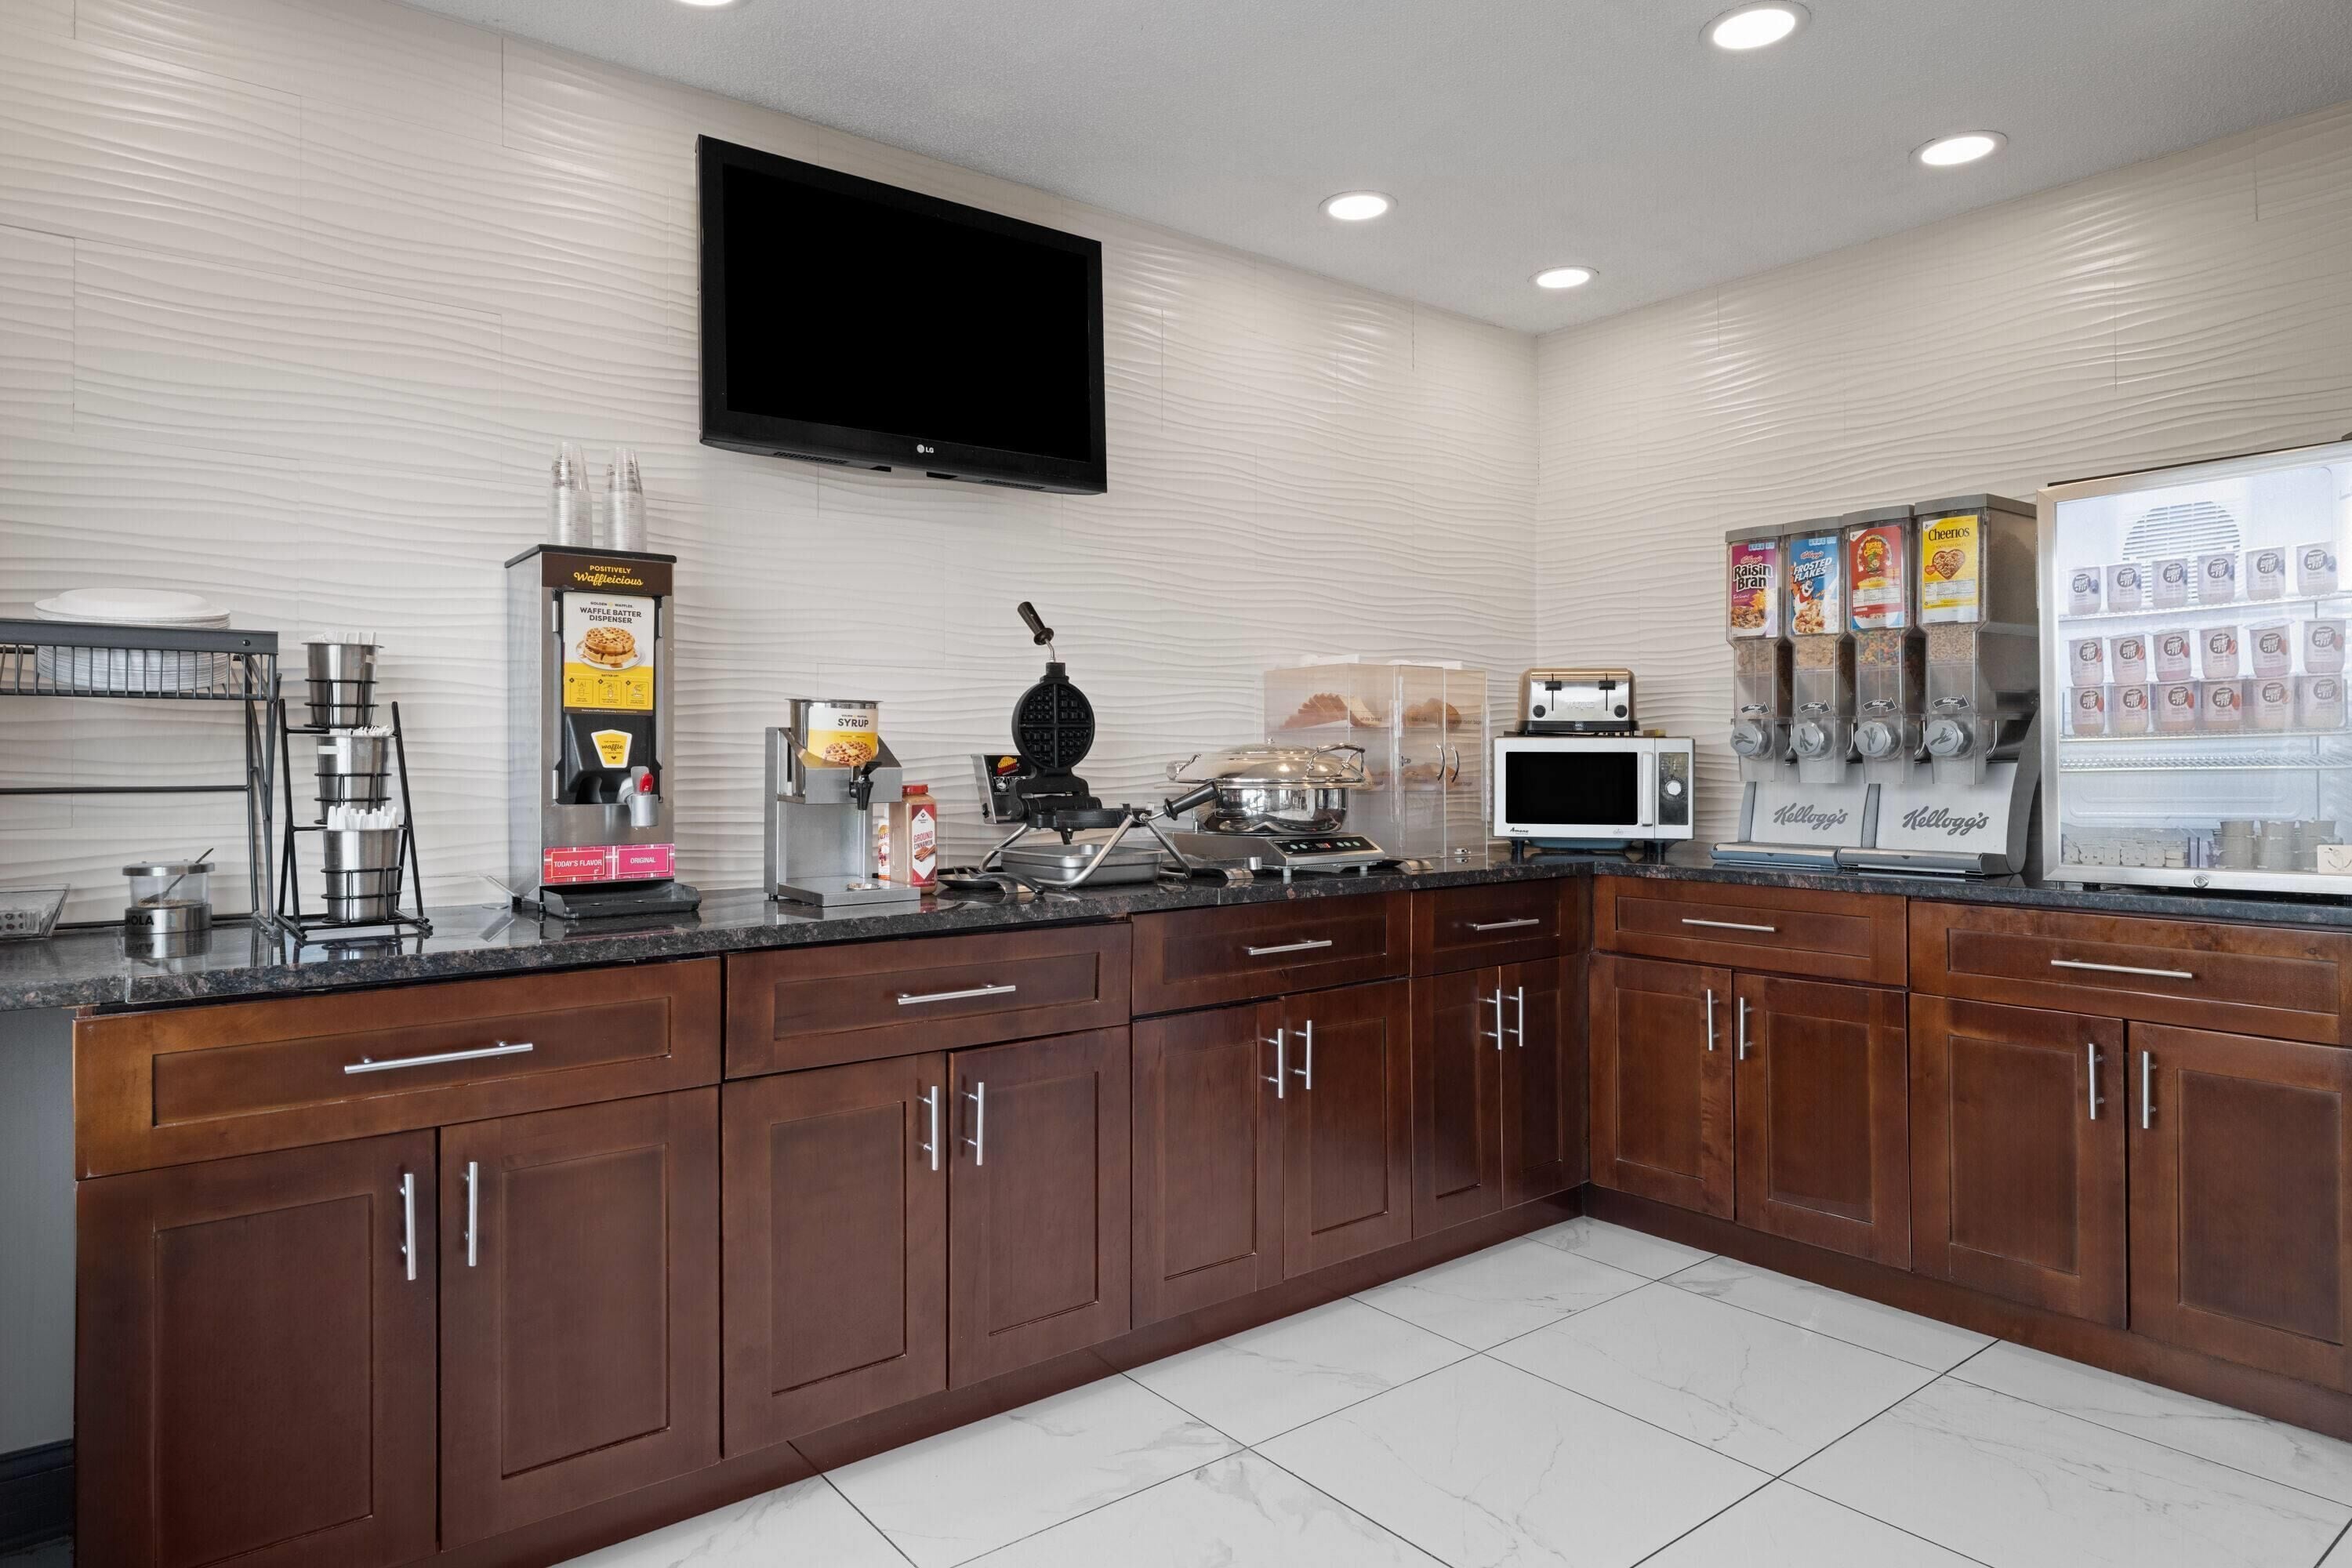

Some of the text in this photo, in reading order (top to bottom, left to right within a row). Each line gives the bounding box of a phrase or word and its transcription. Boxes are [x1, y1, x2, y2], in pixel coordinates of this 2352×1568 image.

[1929, 528, 1970, 542] Cheerios
[590, 565, 631, 574] POSITIVELY
[1794, 557, 1832, 575] FROSTED
[2211, 563, 2227, 572] LIGHT
[1734, 564, 1772, 579] Raisin
[1794, 567, 1826, 583] FLAKES
[574, 572, 644, 586] Waffleicious
[1737, 577, 1766, 590] Bran
[580, 607, 611, 615] WAFFLE
[590, 615, 633, 624] DISPENSER
[2168, 641, 2182, 649] LIGHT
[2213, 637, 2229, 647] LIGHT
[2263, 637, 2279, 647] LIGHT
[2082, 645, 2096, 655] LIGHT
[2123, 644, 2137, 652] LIGHT
[2172, 691, 2187, 700] LIGHT
[2216, 693, 2232, 702] LIGHT
[837, 718, 869, 728] SYRUP
[1773, 803, 1848, 830] Kellogg's
[1902, 806, 1989, 836] Kellogg's
[913, 831, 933, 843] GROUND
[914, 840, 933, 850] CINNAMON
